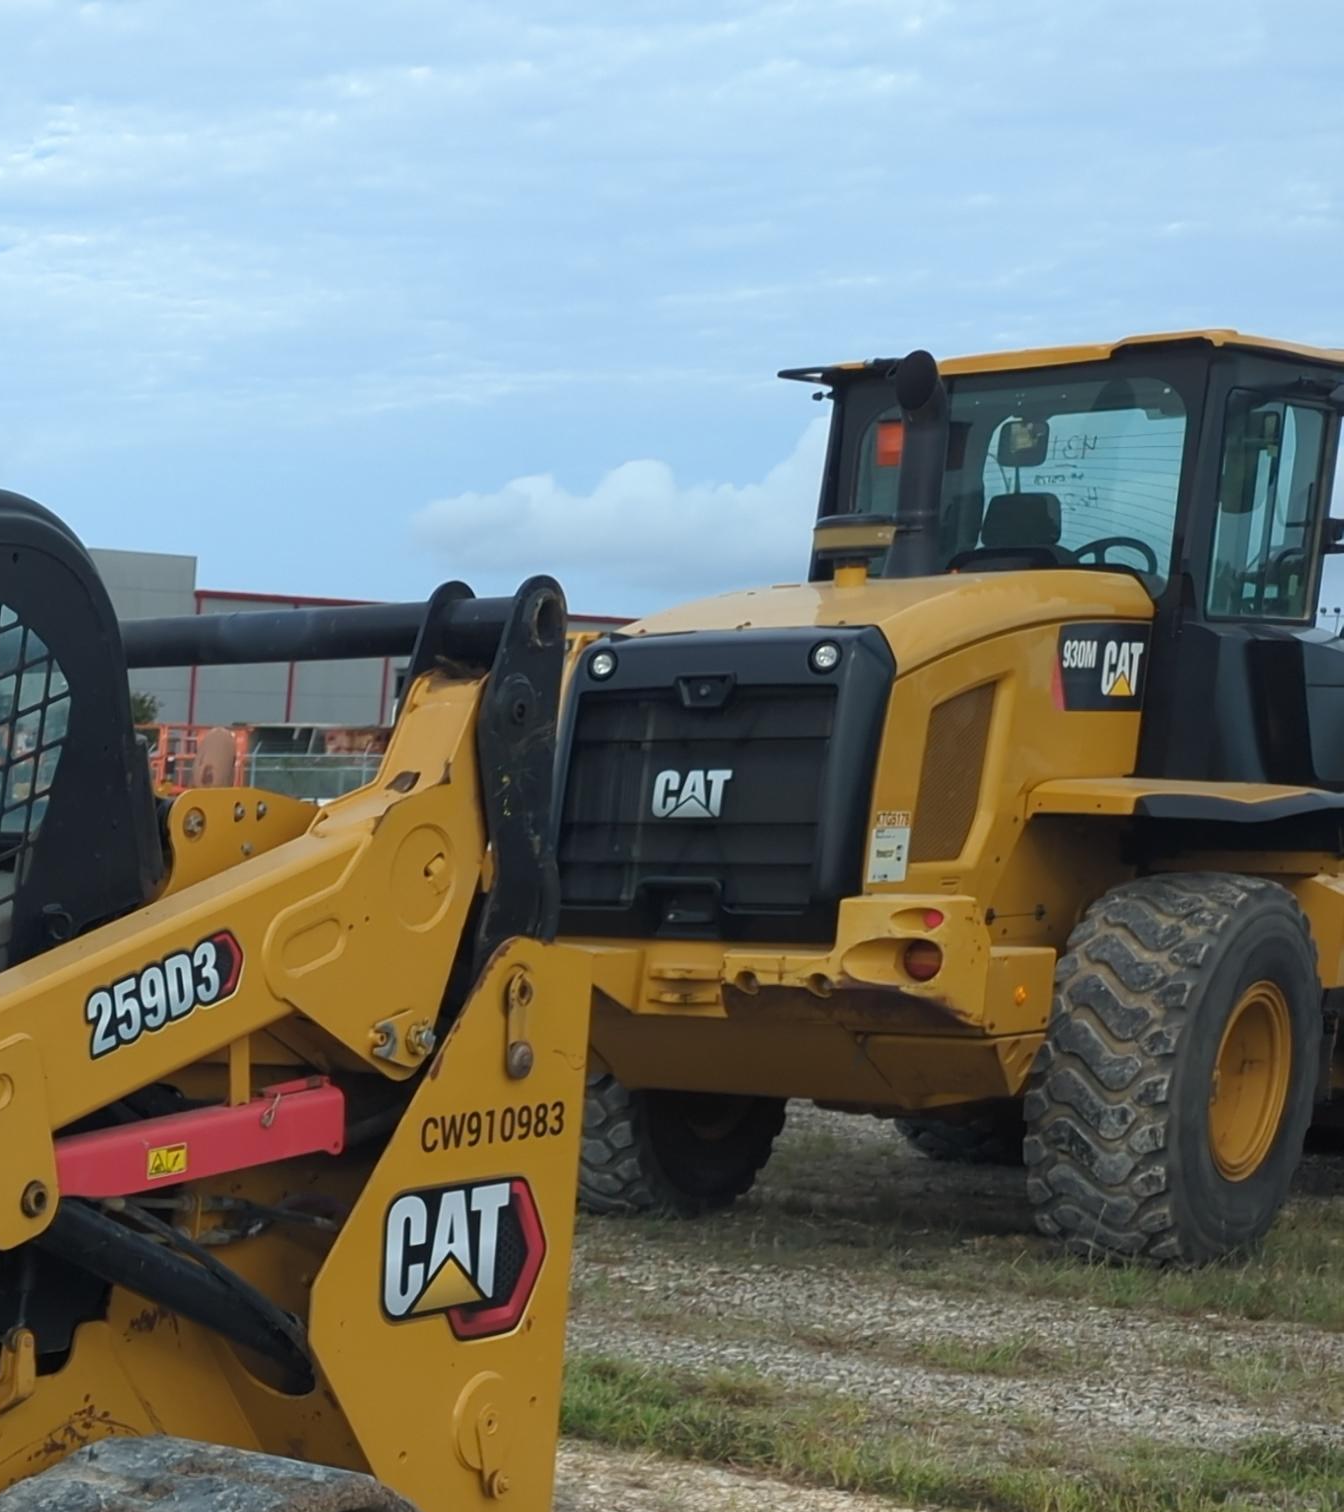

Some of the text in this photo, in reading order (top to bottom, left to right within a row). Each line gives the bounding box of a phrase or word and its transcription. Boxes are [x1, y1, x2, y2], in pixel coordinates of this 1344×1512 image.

[1062, 639, 1145, 697] 930M CAT
[652, 769, 733, 818] CAT
[87, 941, 221, 1056] 259D3
[421, 1101, 565, 1153] CW910983
[384, 1182, 511, 1317] CAT
